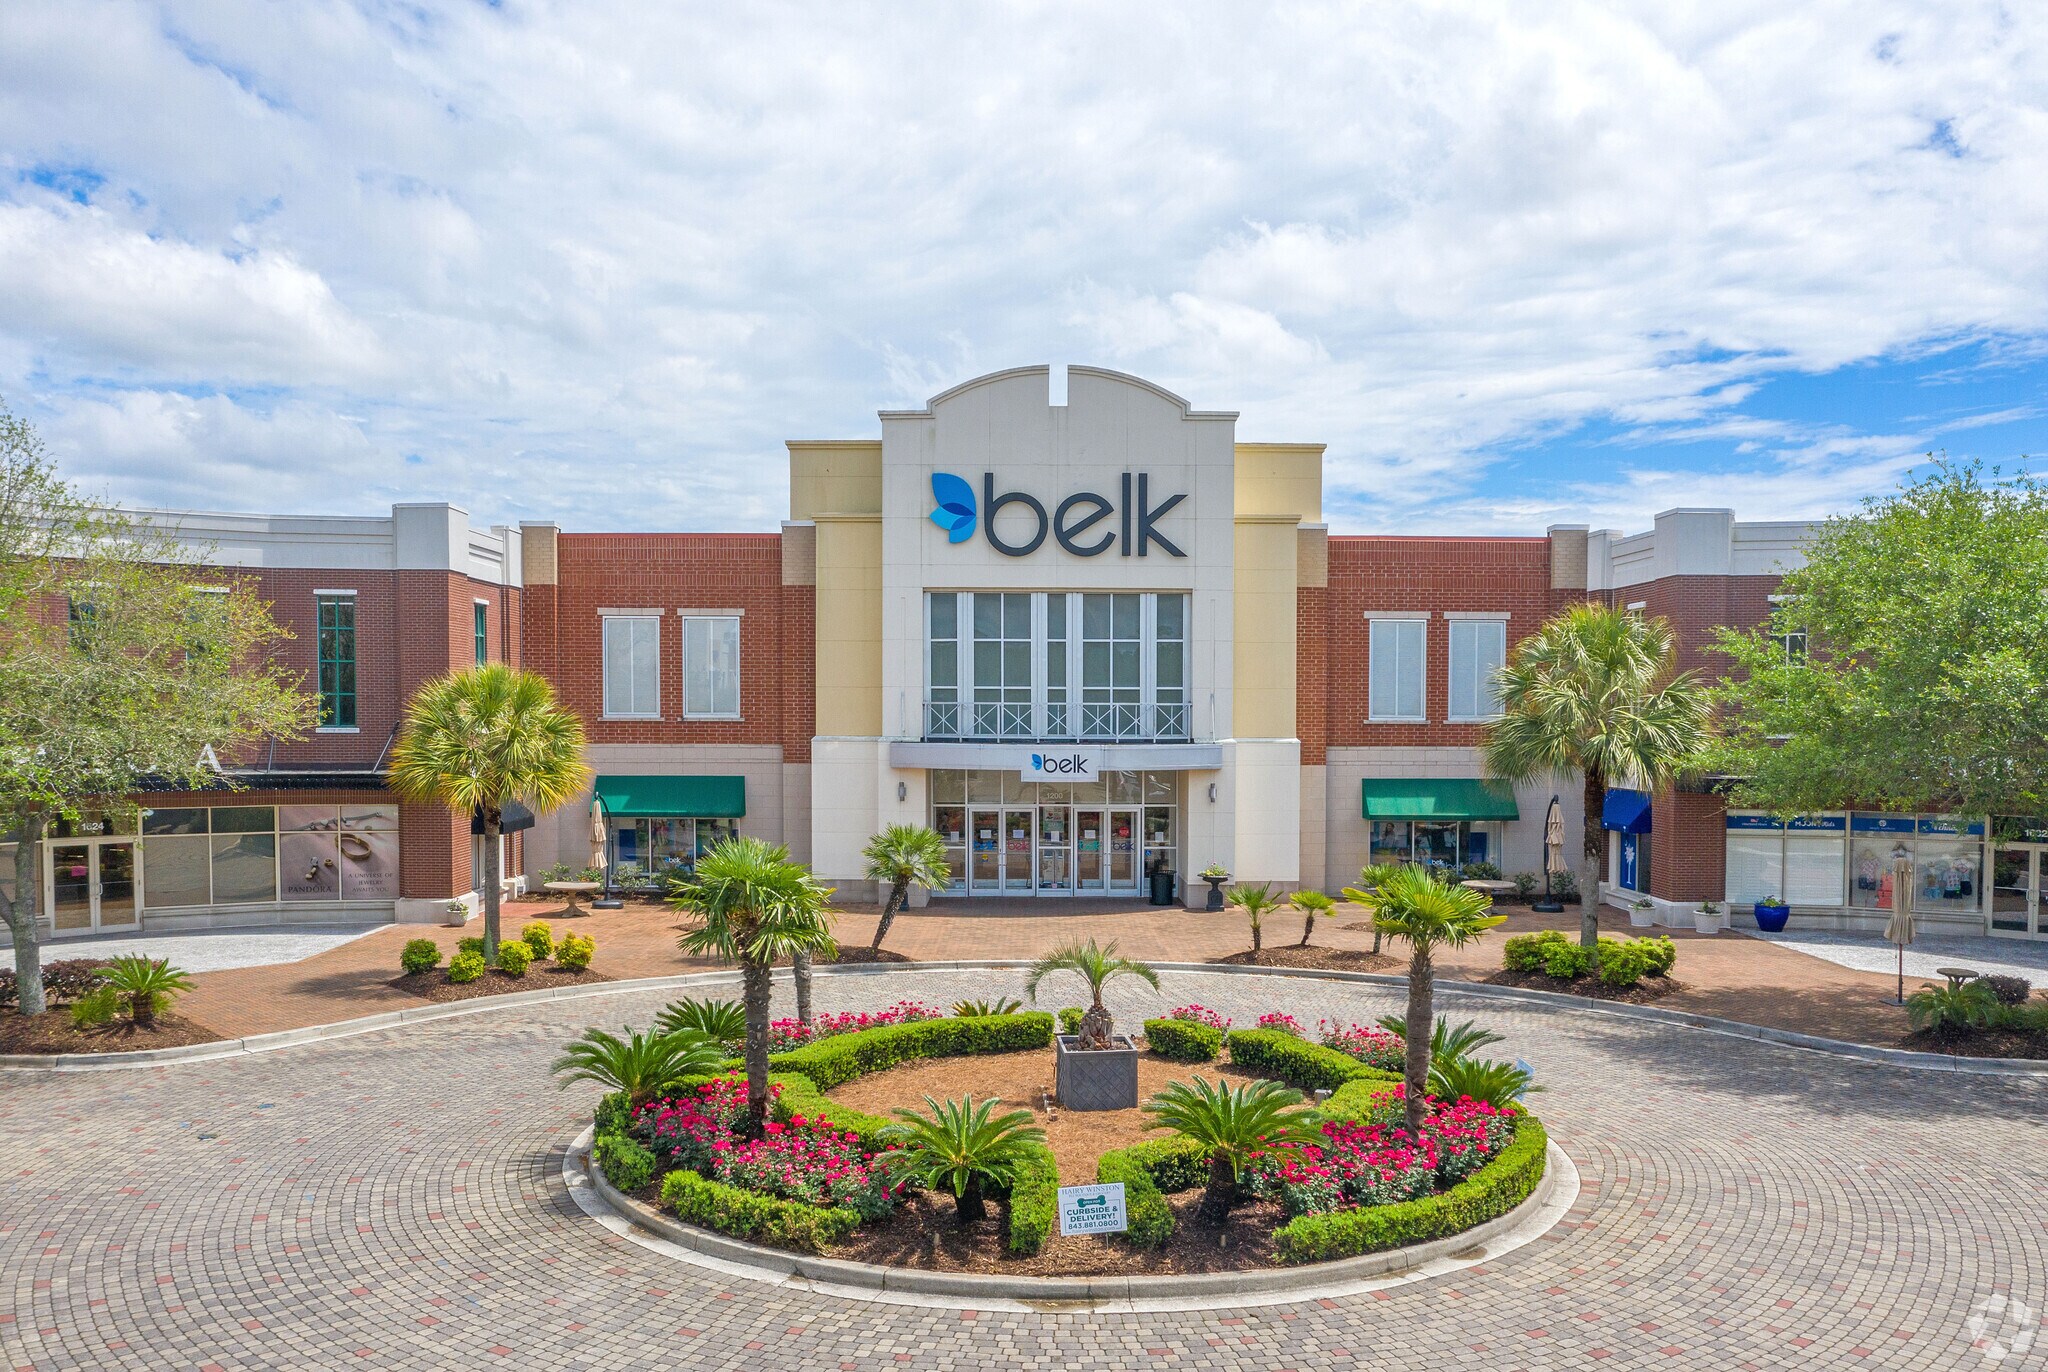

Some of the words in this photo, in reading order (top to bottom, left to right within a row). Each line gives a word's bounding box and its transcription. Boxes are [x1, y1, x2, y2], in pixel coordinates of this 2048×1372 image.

[984, 472, 1189, 557] belk
[1043, 754, 1089, 773] belk
[1046, 792, 1064, 800] 1200
[1062, 1187, 1085, 1195] HAIRY
[1086, 1184, 1120, 1193] WINSTON
[1066, 1206, 1110, 1216] CURBSIDE
[1070, 1212, 1115, 1222] DELIVERY!
[1068, 1219, 1118, 1230] 843.881.0800
